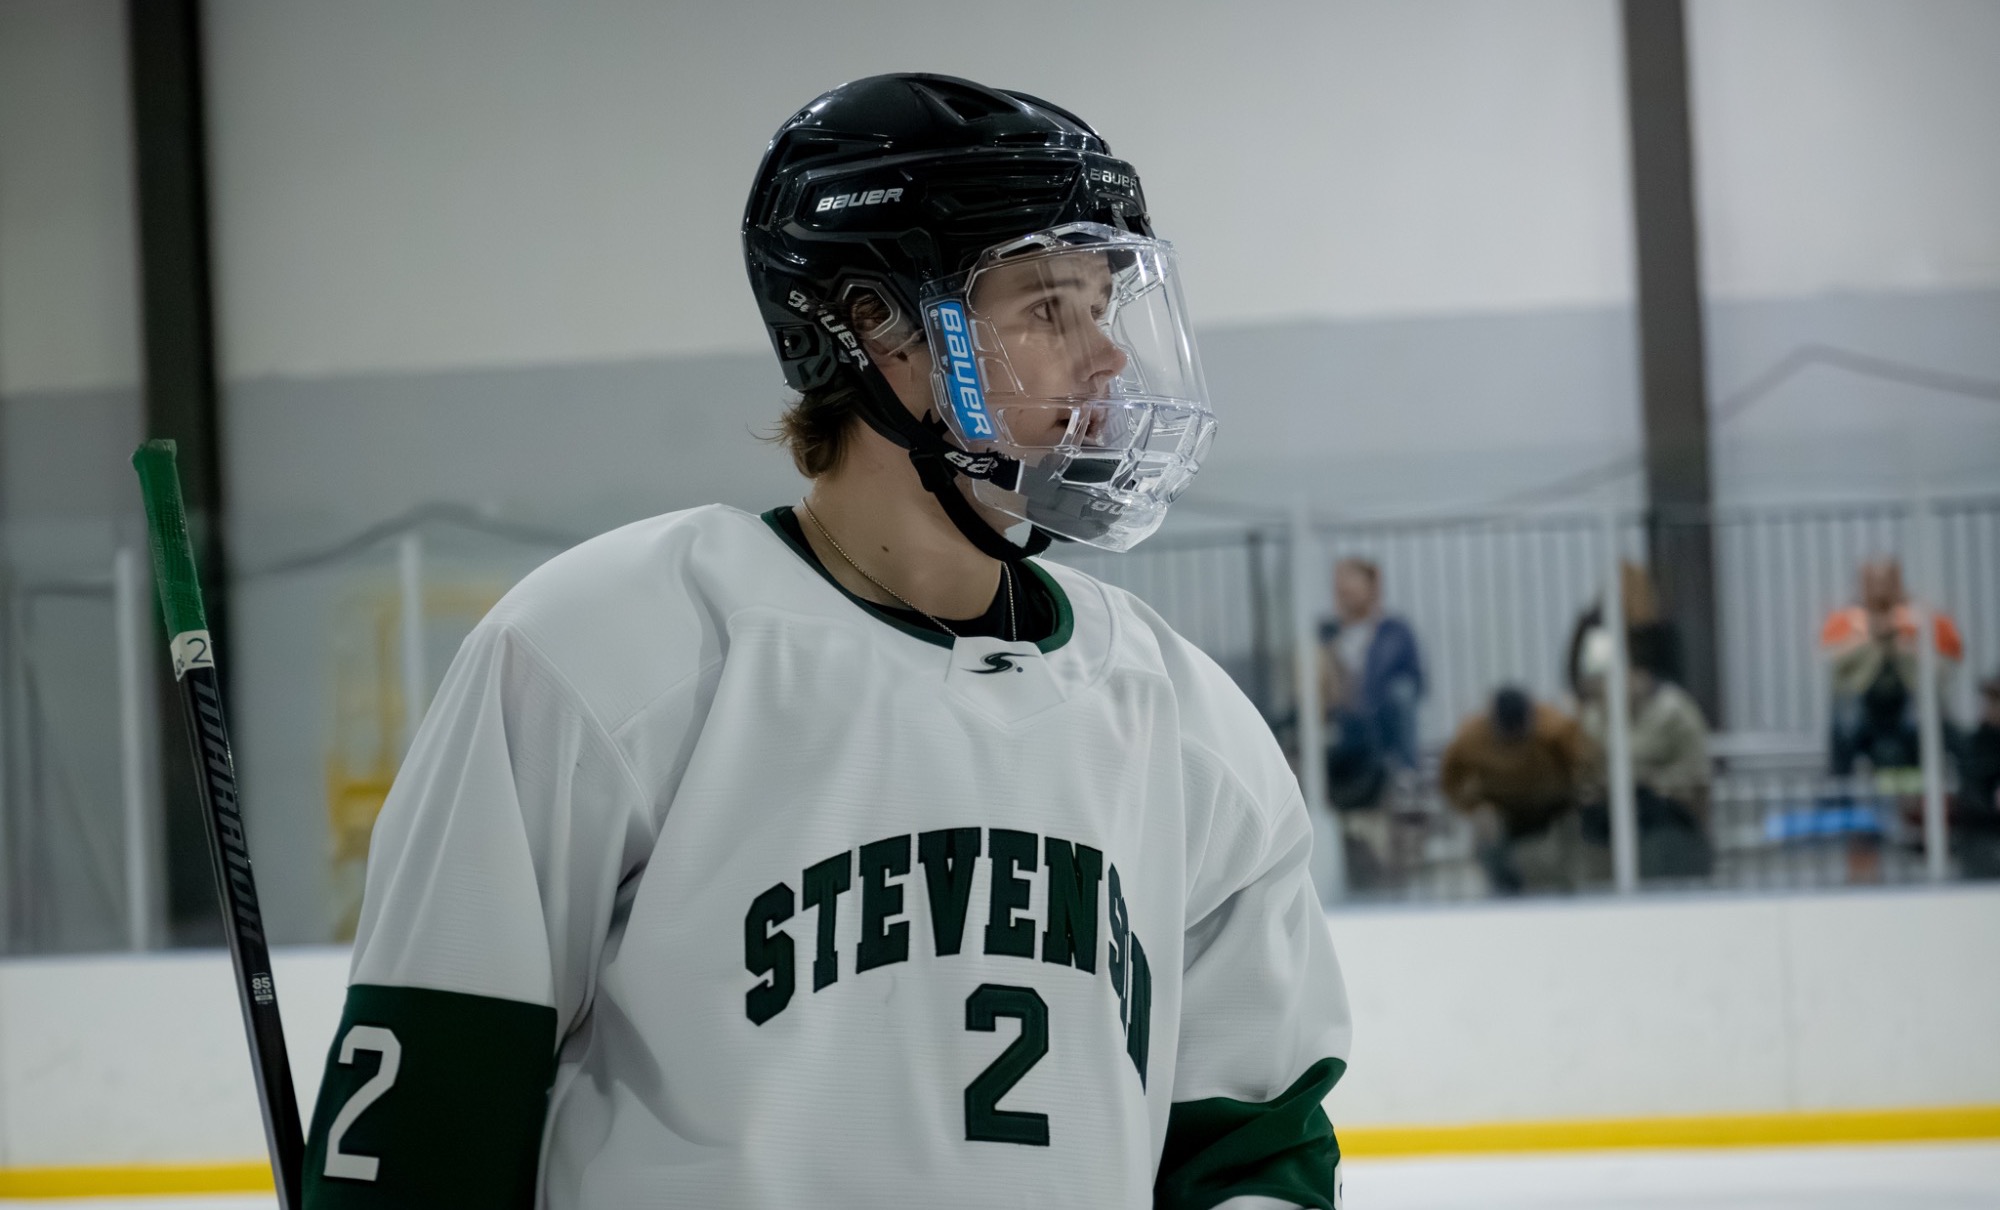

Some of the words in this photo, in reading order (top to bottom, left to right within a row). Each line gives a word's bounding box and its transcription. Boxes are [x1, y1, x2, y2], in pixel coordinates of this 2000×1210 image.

[815, 187, 904, 212] BAUER
[940, 307, 992, 435] BAUER
[186, 637, 212, 664] 2
[194, 680, 263, 944] WARRIOR
[252, 976, 271, 990] 85
[323, 1025, 402, 1182] 2
[965, 983, 1050, 1146] 2
